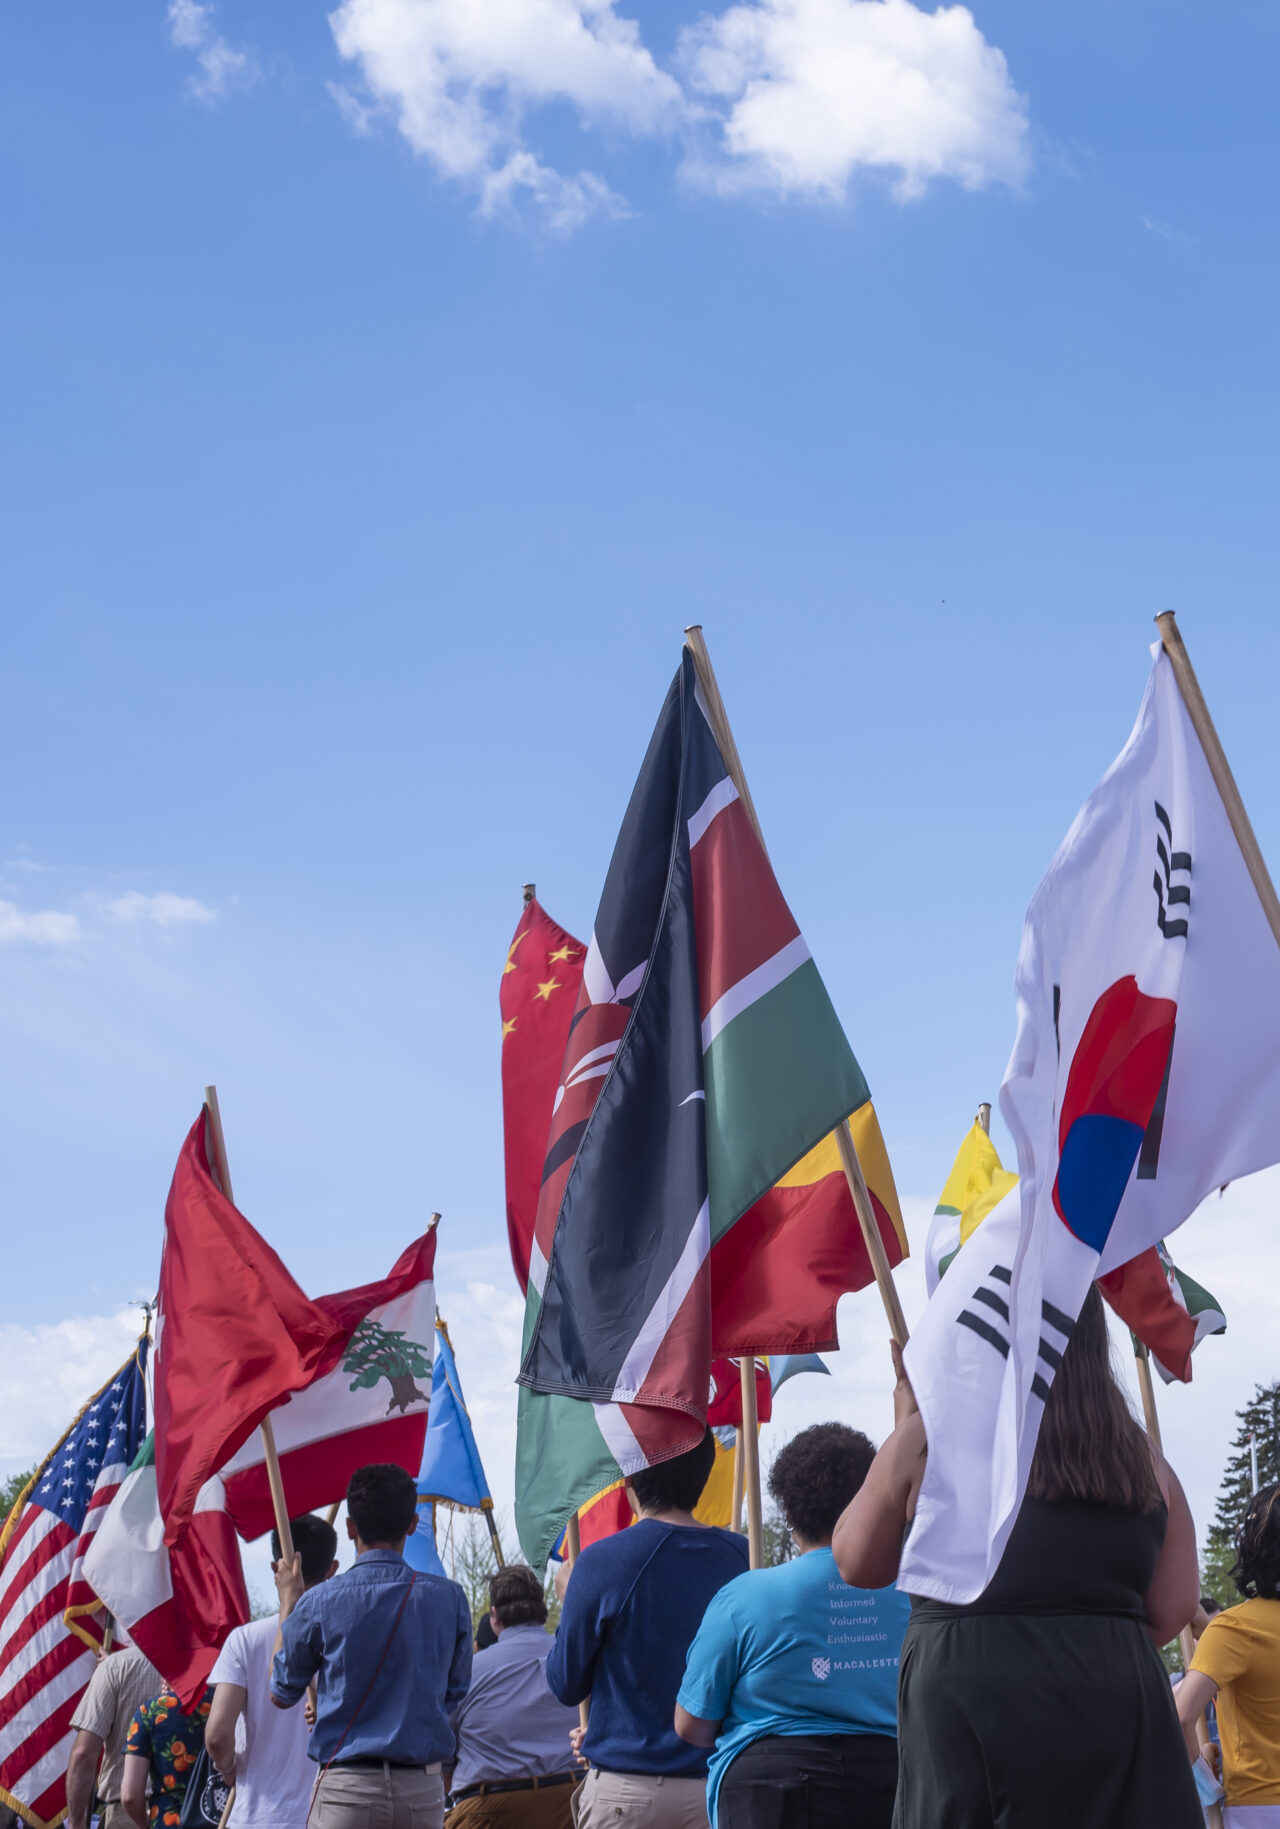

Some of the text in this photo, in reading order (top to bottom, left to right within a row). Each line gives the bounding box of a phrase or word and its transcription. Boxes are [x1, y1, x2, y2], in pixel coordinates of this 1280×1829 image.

[830, 1596, 875, 1608] Informed
[829, 1616, 878, 1626] Voluntary
[827, 1632, 888, 1644] Enthusiastic
